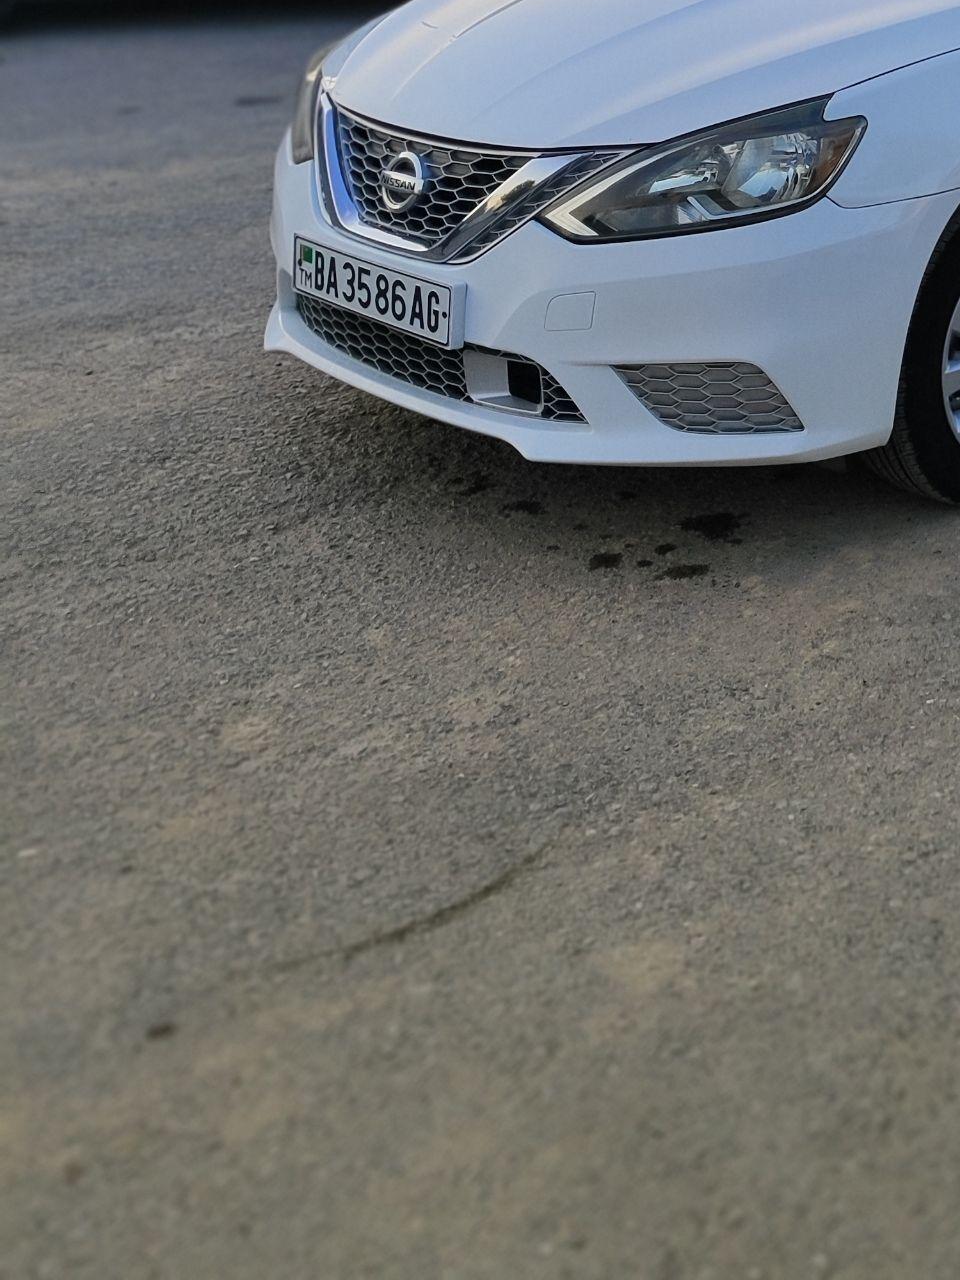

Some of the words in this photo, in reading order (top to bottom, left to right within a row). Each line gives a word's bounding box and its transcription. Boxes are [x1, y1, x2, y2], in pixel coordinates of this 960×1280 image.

[382, 174, 416, 190] NISSAN
[299, 268, 313, 289] TM
[314, 250, 440, 333] BA3586AG
